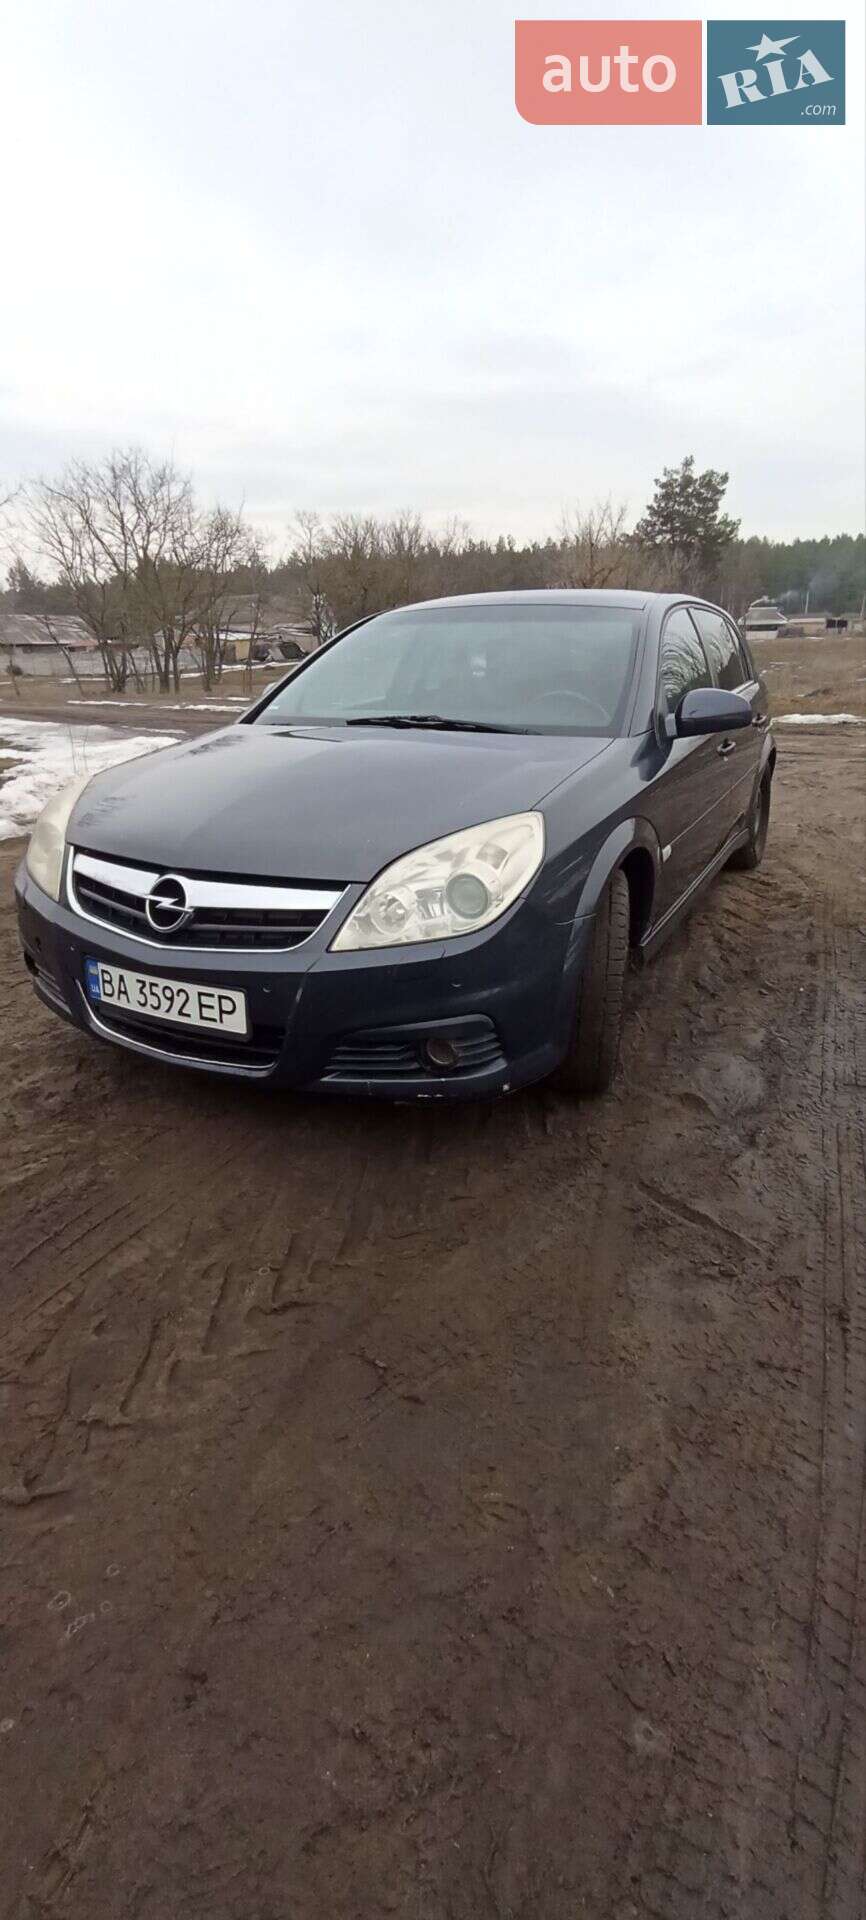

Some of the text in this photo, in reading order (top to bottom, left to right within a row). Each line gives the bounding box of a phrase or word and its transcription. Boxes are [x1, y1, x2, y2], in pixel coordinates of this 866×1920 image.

[101, 969, 237, 1024] BA 3592 EP
